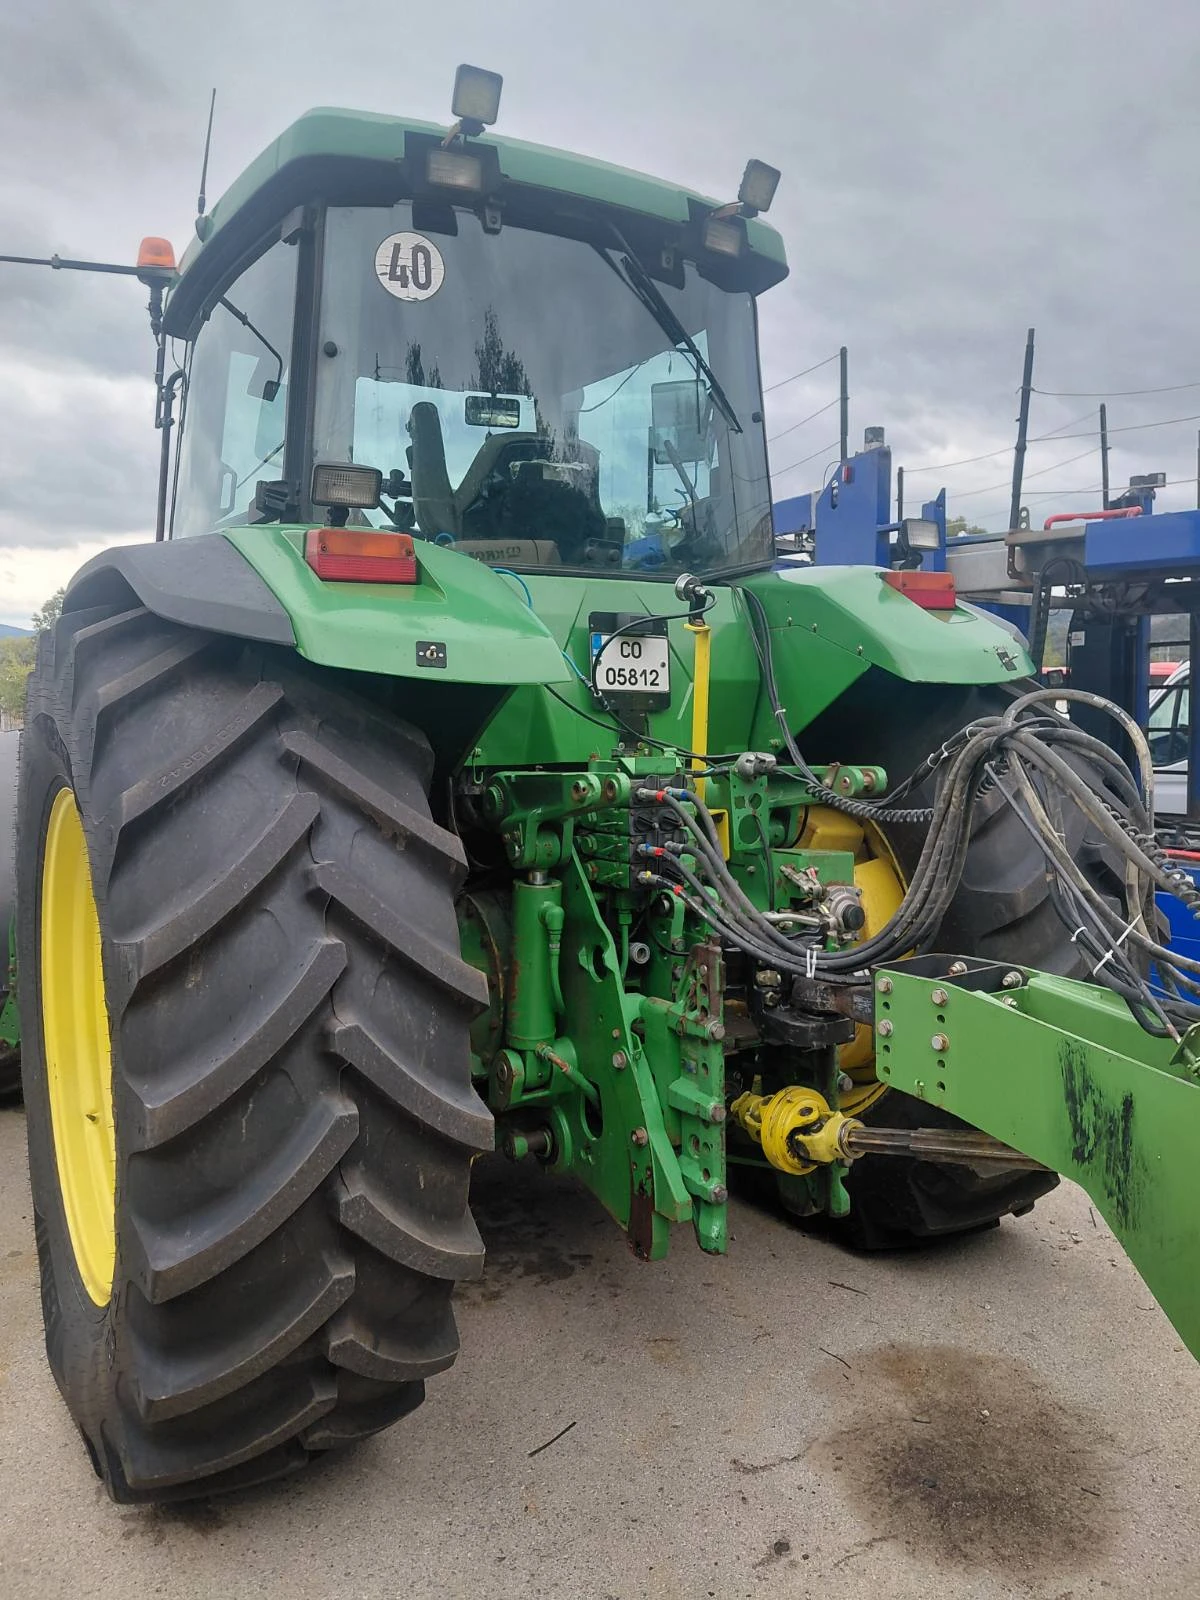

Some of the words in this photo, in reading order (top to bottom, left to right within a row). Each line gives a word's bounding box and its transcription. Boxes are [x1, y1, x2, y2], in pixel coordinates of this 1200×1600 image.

[388, 242, 432, 290] 40
[620, 641, 642, 659] CO
[605, 667, 660, 687] 05812
